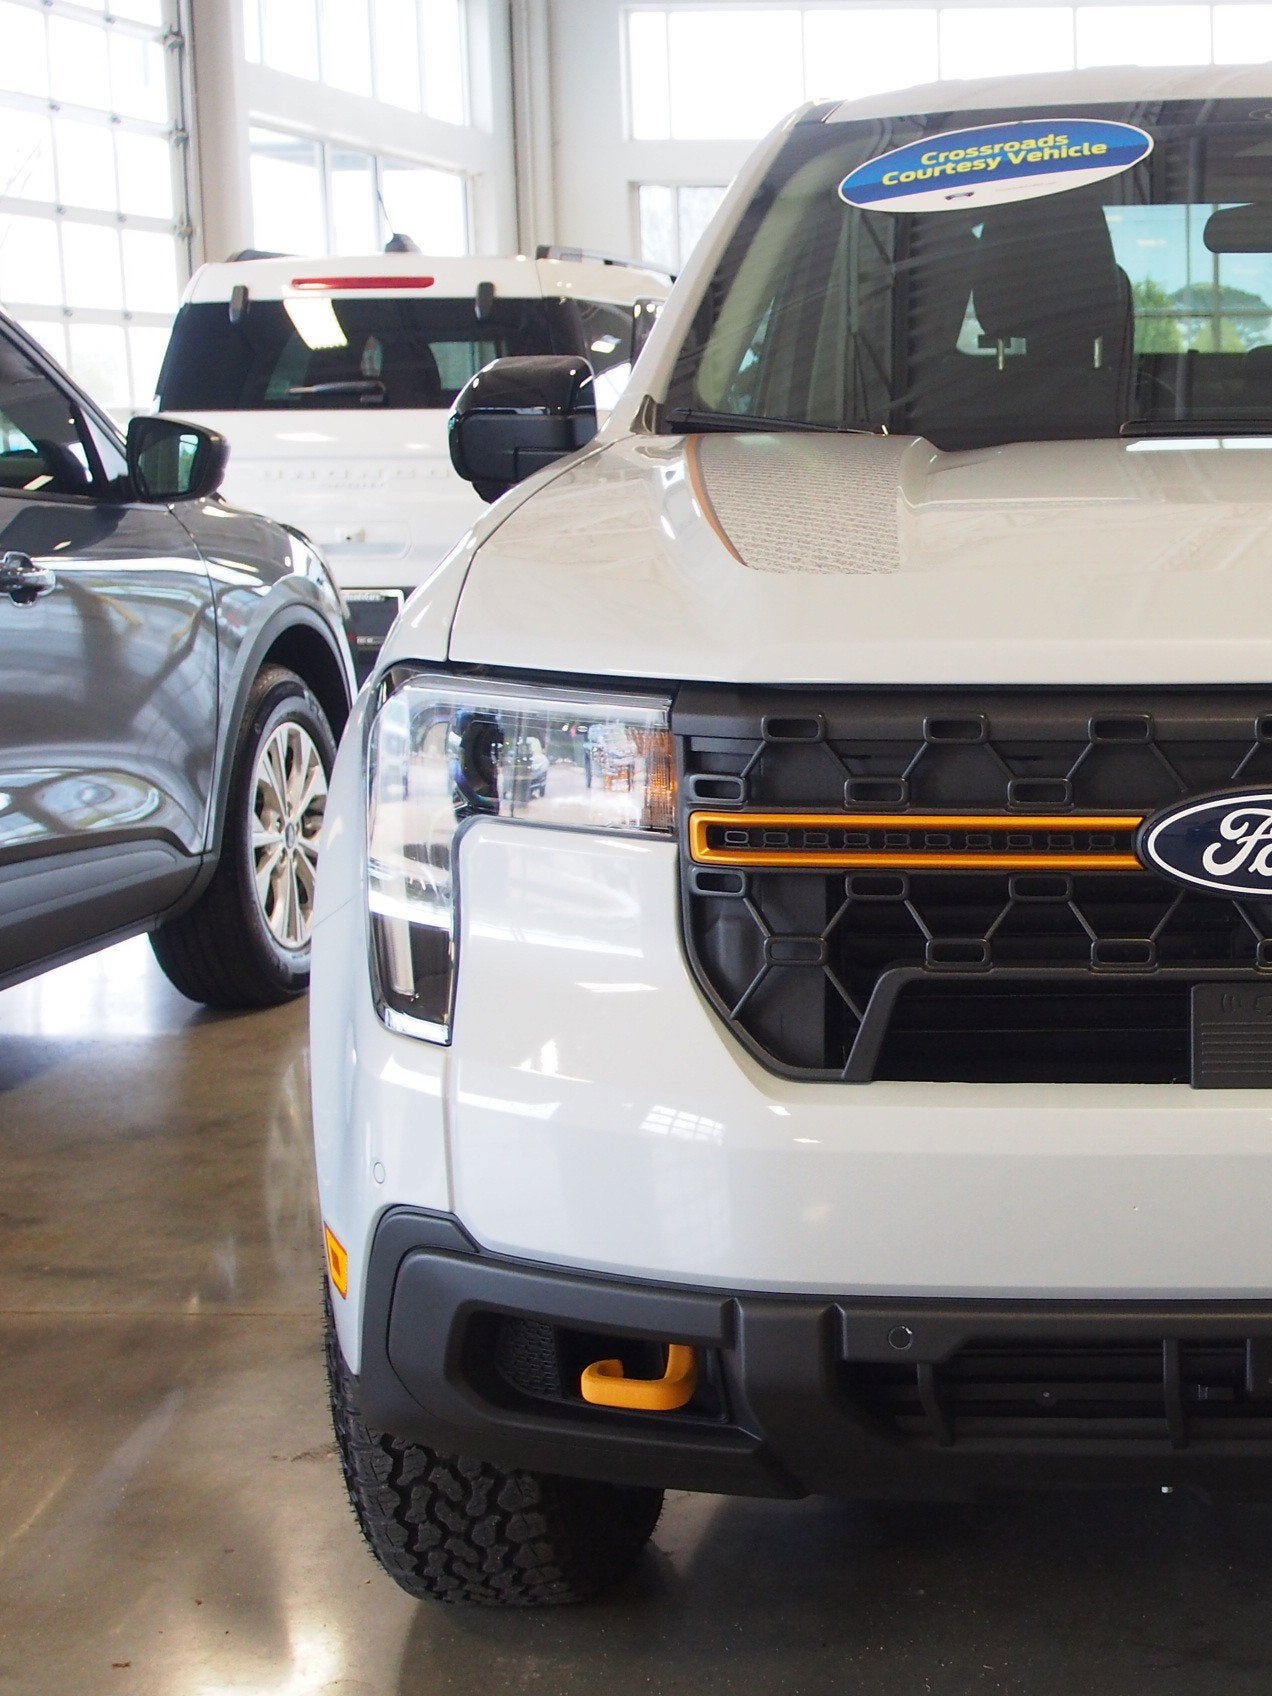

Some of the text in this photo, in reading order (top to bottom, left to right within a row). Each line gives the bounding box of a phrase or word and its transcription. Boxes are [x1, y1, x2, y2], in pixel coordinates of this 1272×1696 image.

[881, 142, 1108, 186] Courtesy Vehicle
[920, 133, 1068, 166] Crossroads
